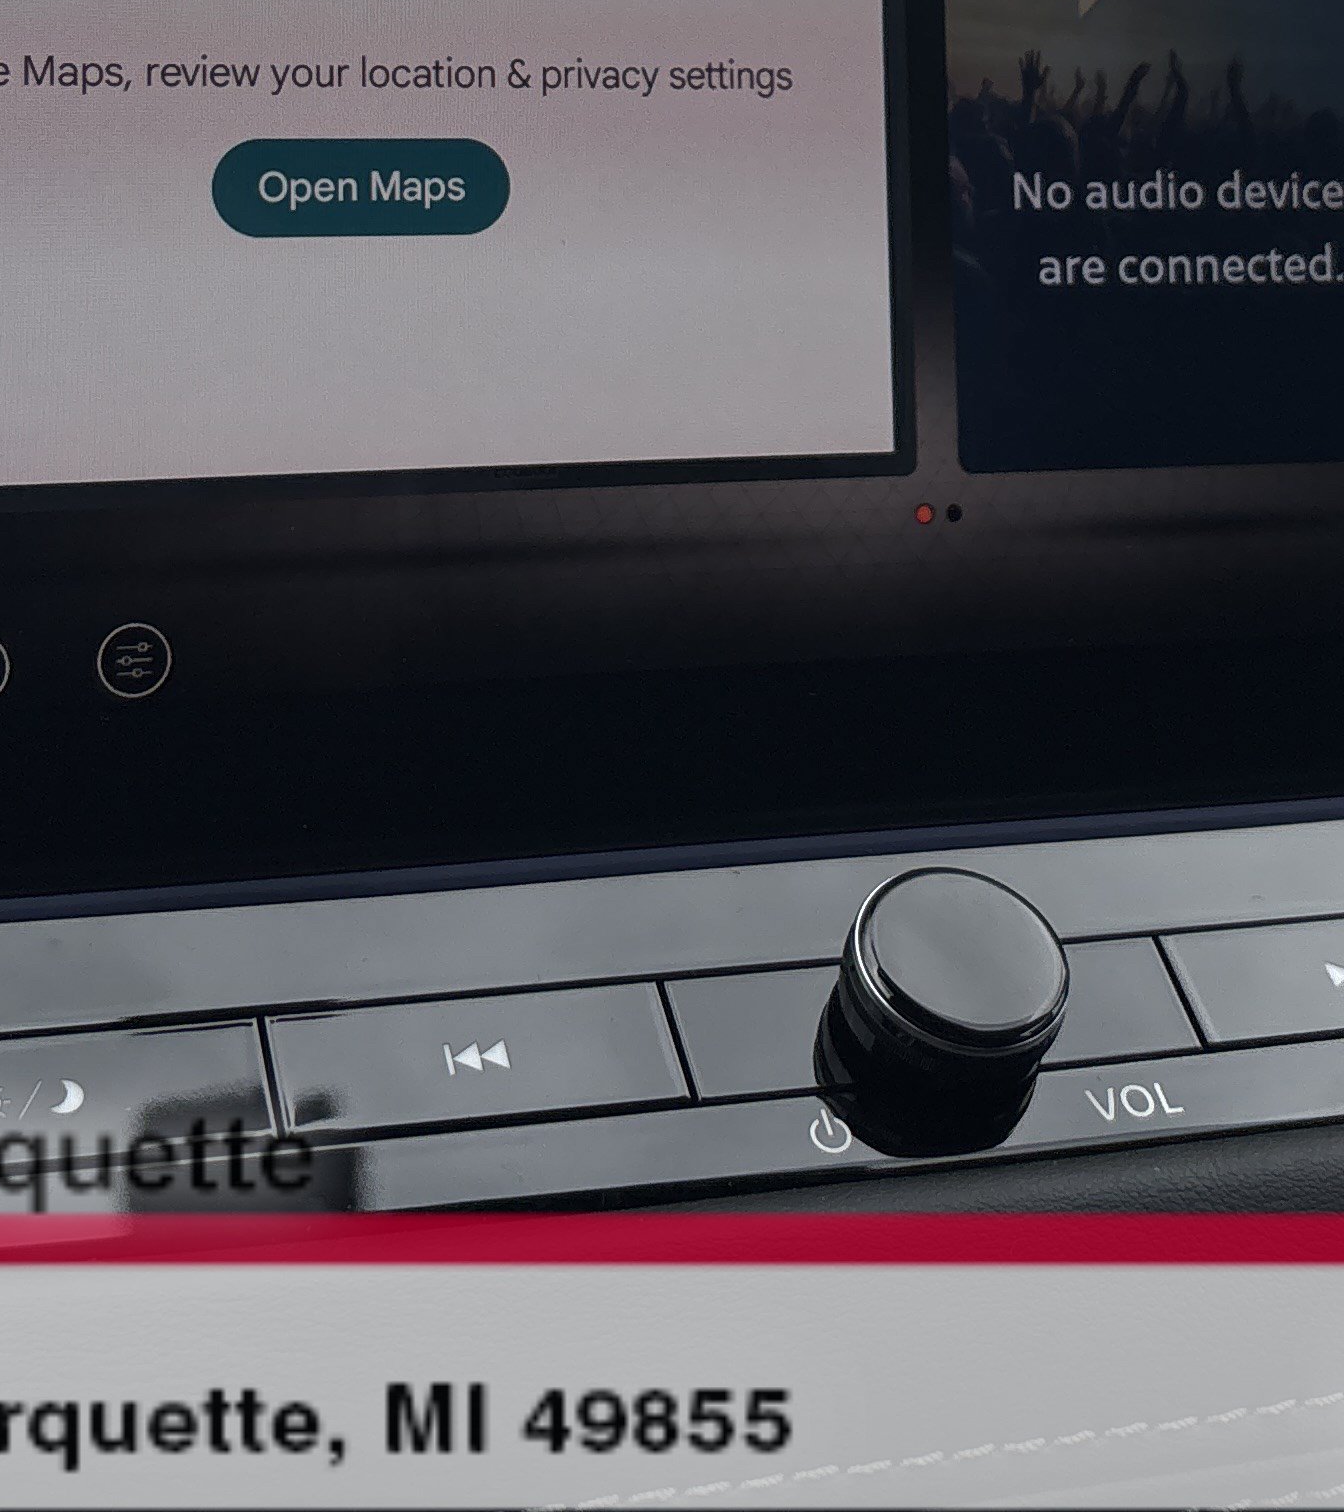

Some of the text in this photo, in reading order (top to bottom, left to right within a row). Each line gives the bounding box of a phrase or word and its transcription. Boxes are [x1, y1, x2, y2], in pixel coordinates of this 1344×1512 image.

[24, 55, 131, 95] Maps,
[147, 54, 260, 88] review
[270, 64, 349, 95] your
[362, 55, 496, 88] location
[507, 58, 531, 89] &
[542, 58, 659, 97] privacy
[670, 58, 793, 99] settings
[259, 171, 465, 210] Open Maps
[1014, 172, 1071, 209] No
[1086, 170, 1203, 209] audio
[1039, 243, 1343, 285] are connected.
[1084, 1080, 1183, 1124] VOL
